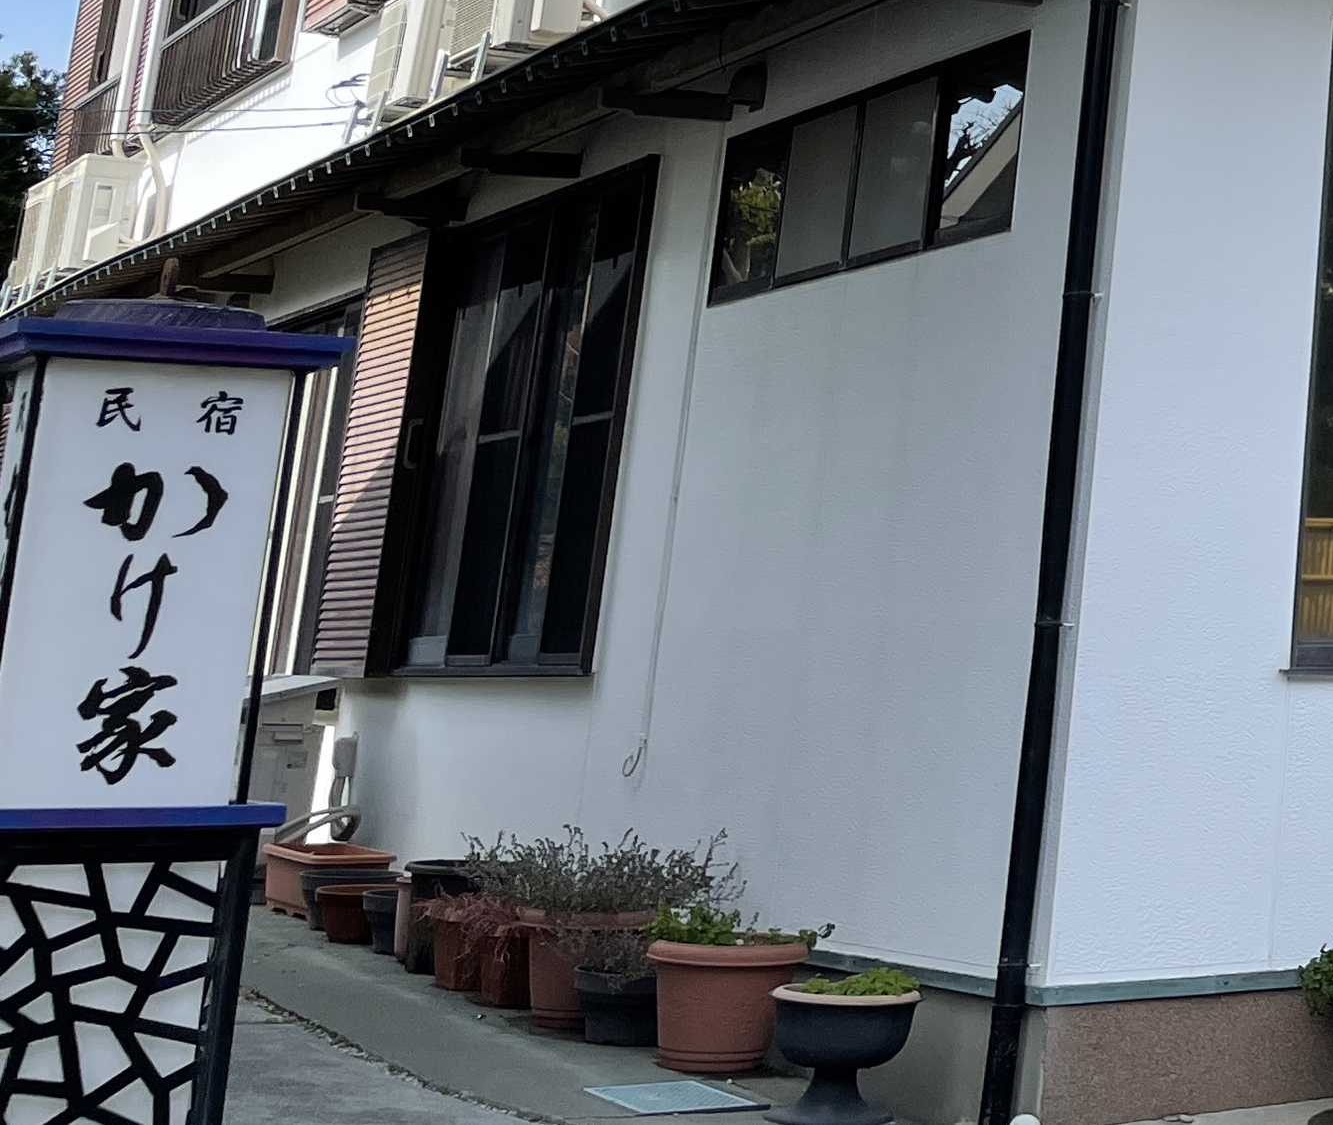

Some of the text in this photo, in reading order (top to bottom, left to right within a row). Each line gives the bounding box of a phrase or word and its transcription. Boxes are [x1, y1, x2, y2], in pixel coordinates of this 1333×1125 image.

[95, 386, 244, 437] 民宿
[76, 462, 229, 786] かけ家
